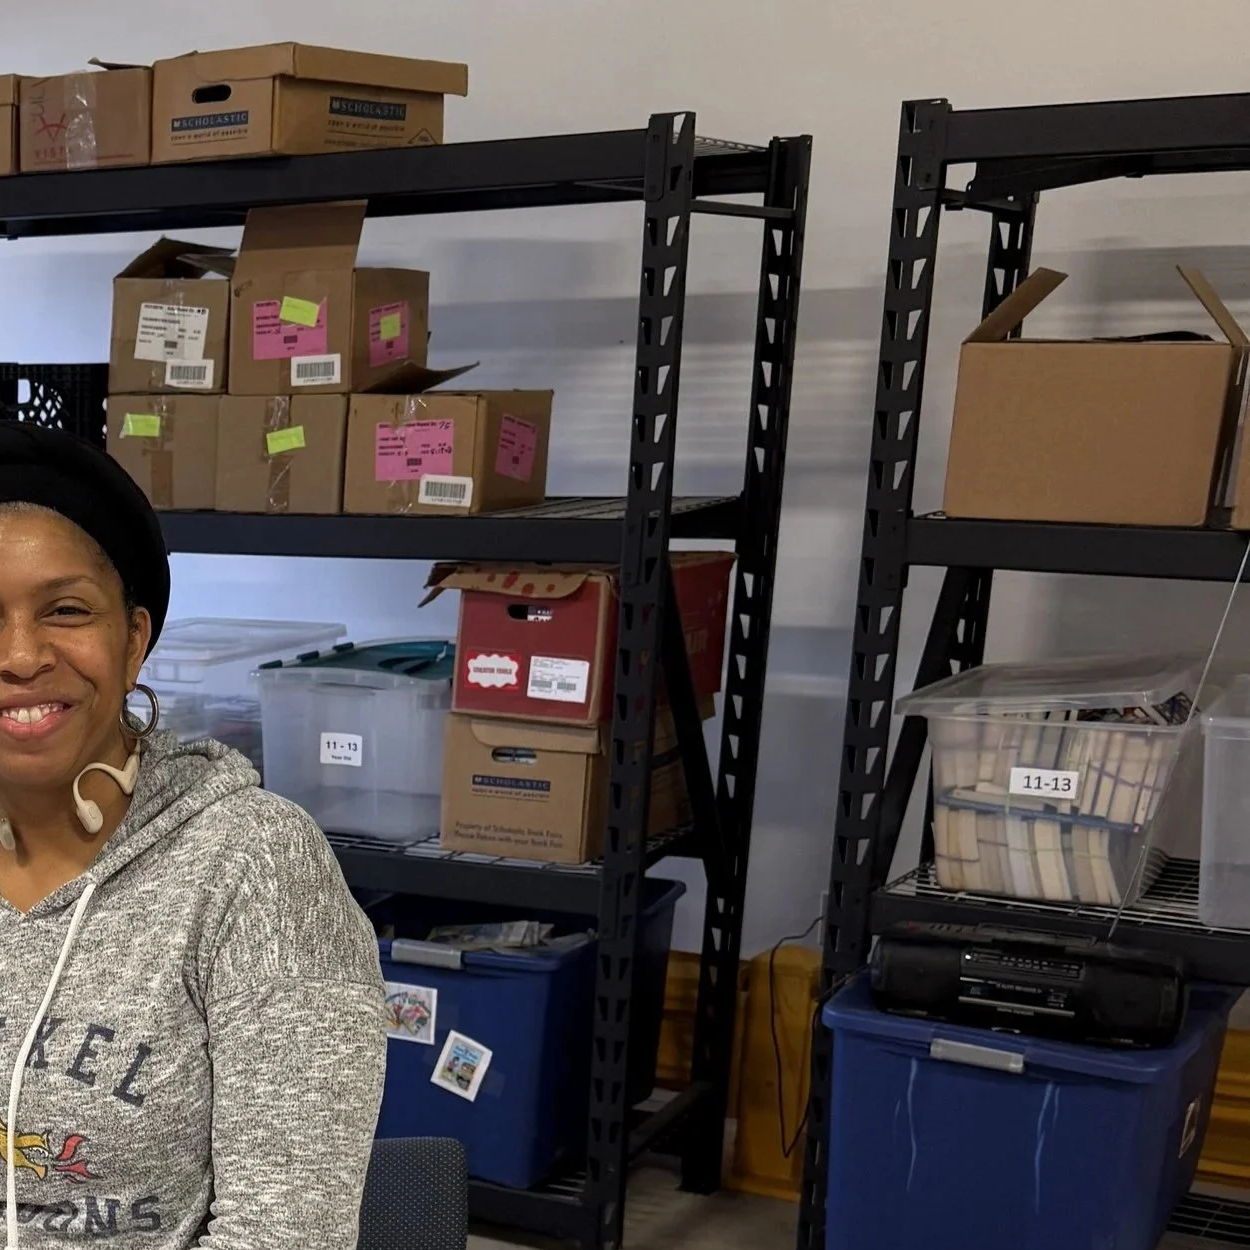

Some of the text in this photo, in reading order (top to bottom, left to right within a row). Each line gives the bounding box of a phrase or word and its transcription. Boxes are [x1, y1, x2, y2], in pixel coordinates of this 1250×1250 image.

[182, 113, 248, 127] SCHOLASTIC
[326, 741, 337, 750] 11
[347, 742, 358, 752] 13
[1022, 774, 1072, 793] 11-13
